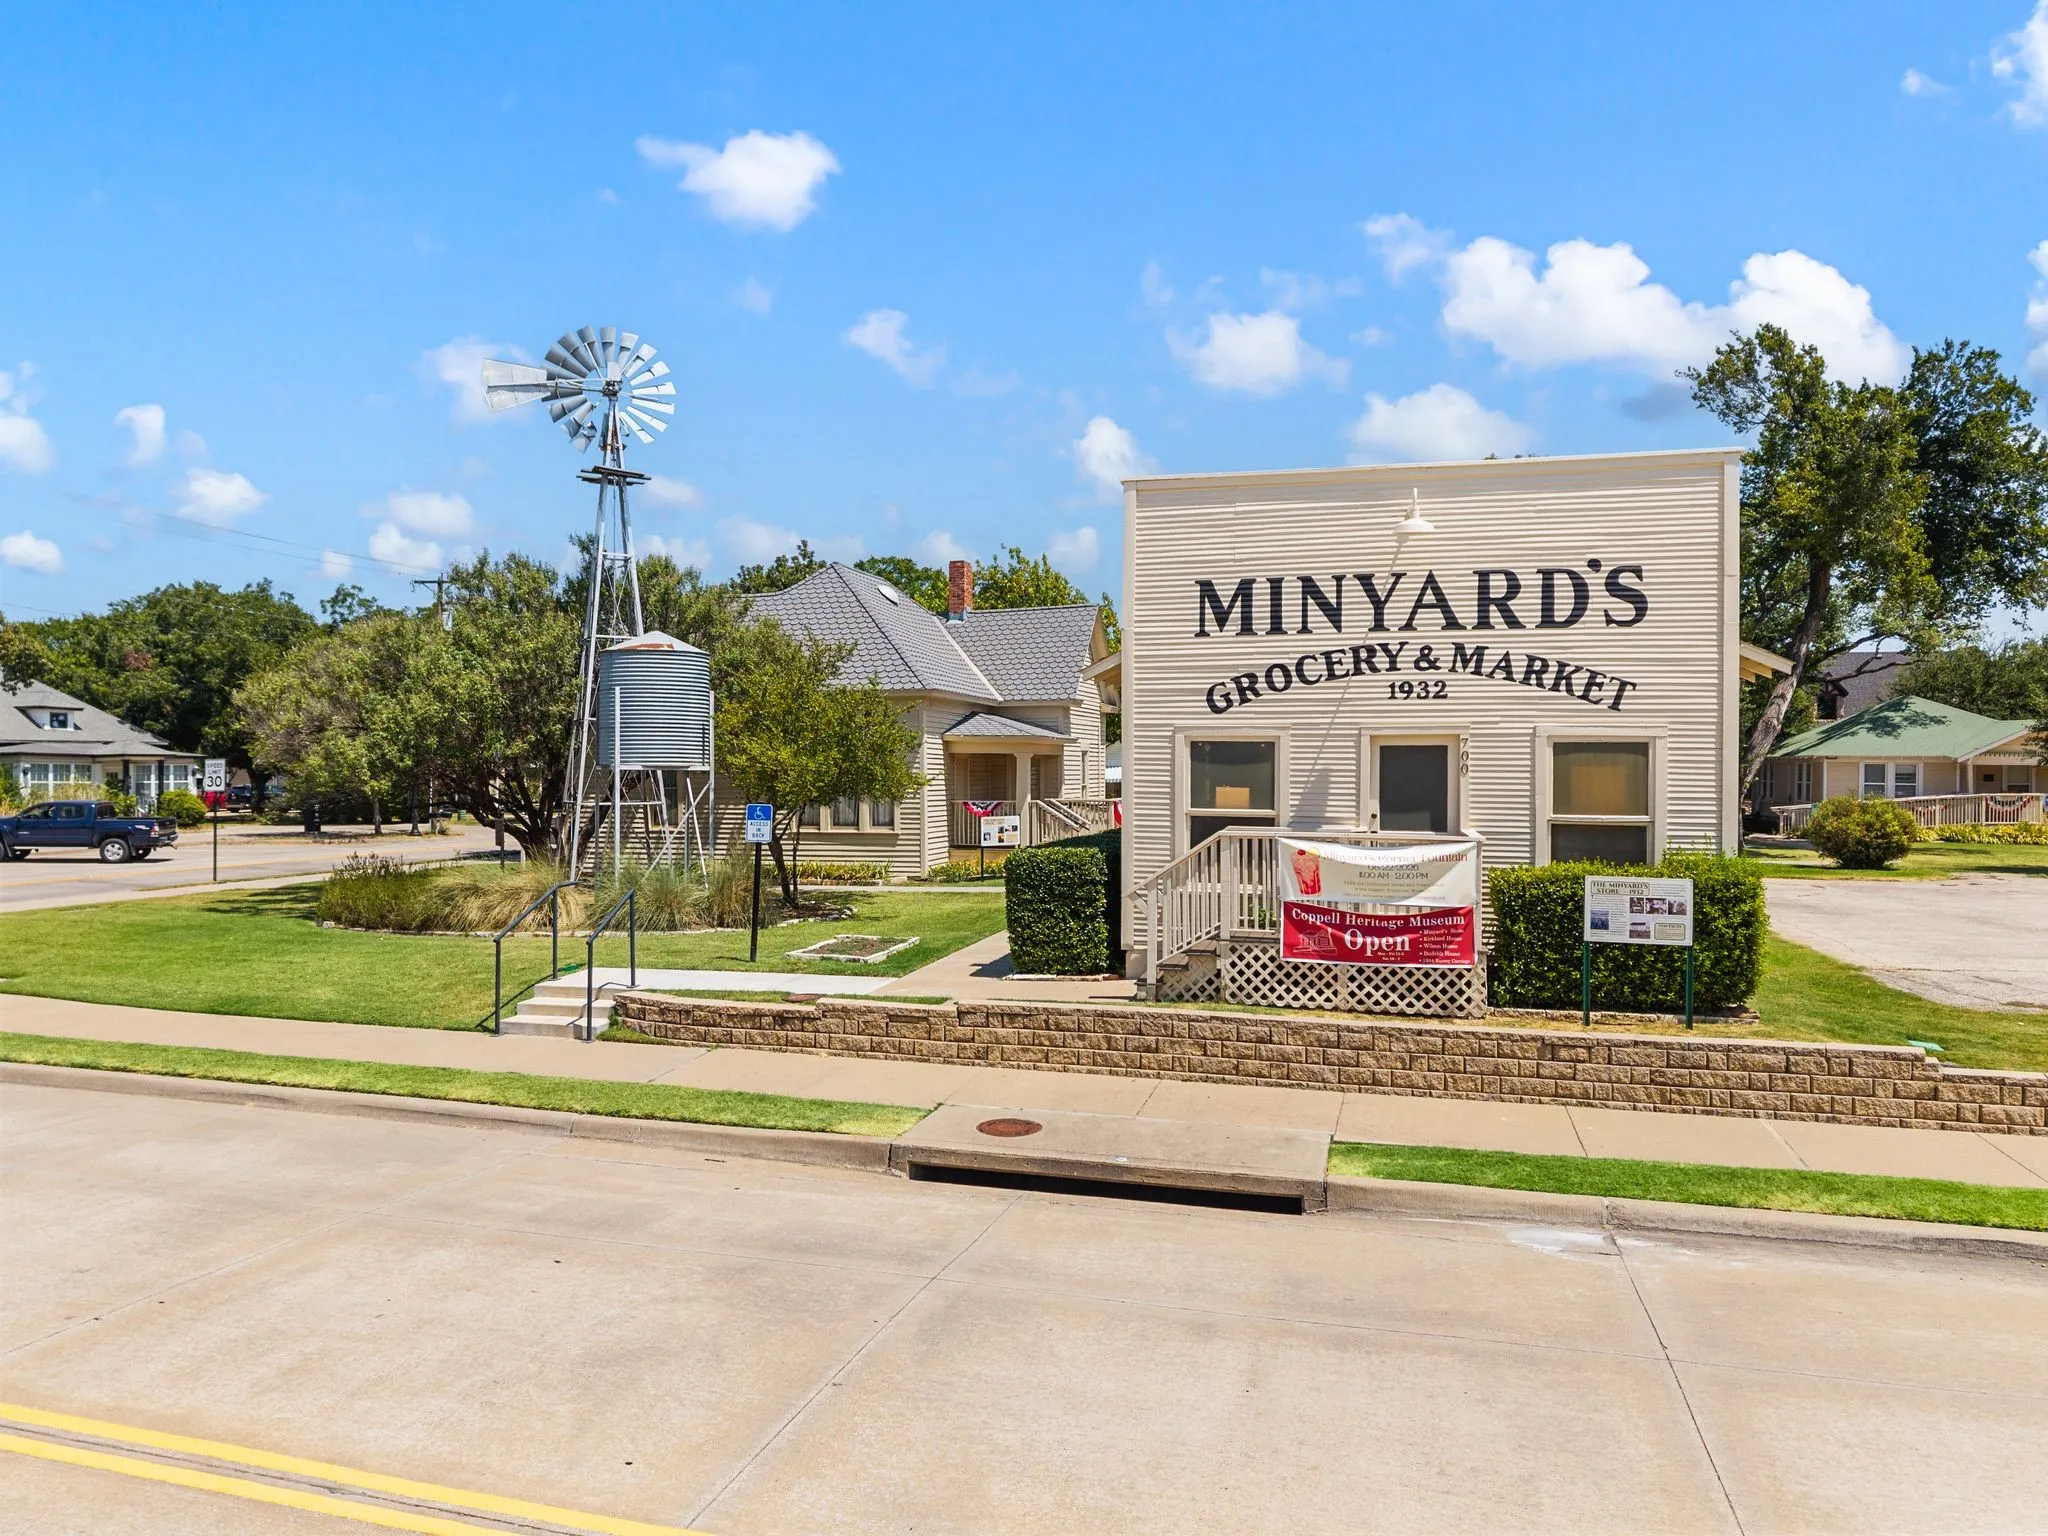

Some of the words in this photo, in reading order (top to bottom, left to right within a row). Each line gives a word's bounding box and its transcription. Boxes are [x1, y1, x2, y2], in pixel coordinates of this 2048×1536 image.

[1194, 558, 1650, 638] MINYARD'S
[1205, 641, 1409, 715] GROCERY
[1413, 644, 1441, 671] &
[1448, 642, 1637, 713] MARKET
[1388, 681, 1449, 700] 1932
[1461, 737, 1469, 775] 700
[207, 775, 222, 787] 30
[1292, 908, 1340, 925] Coppell
[1345, 914, 1404, 930] Heritage
[1409, 916, 1465, 927] Museum
[1344, 929, 1411, 957] Open
